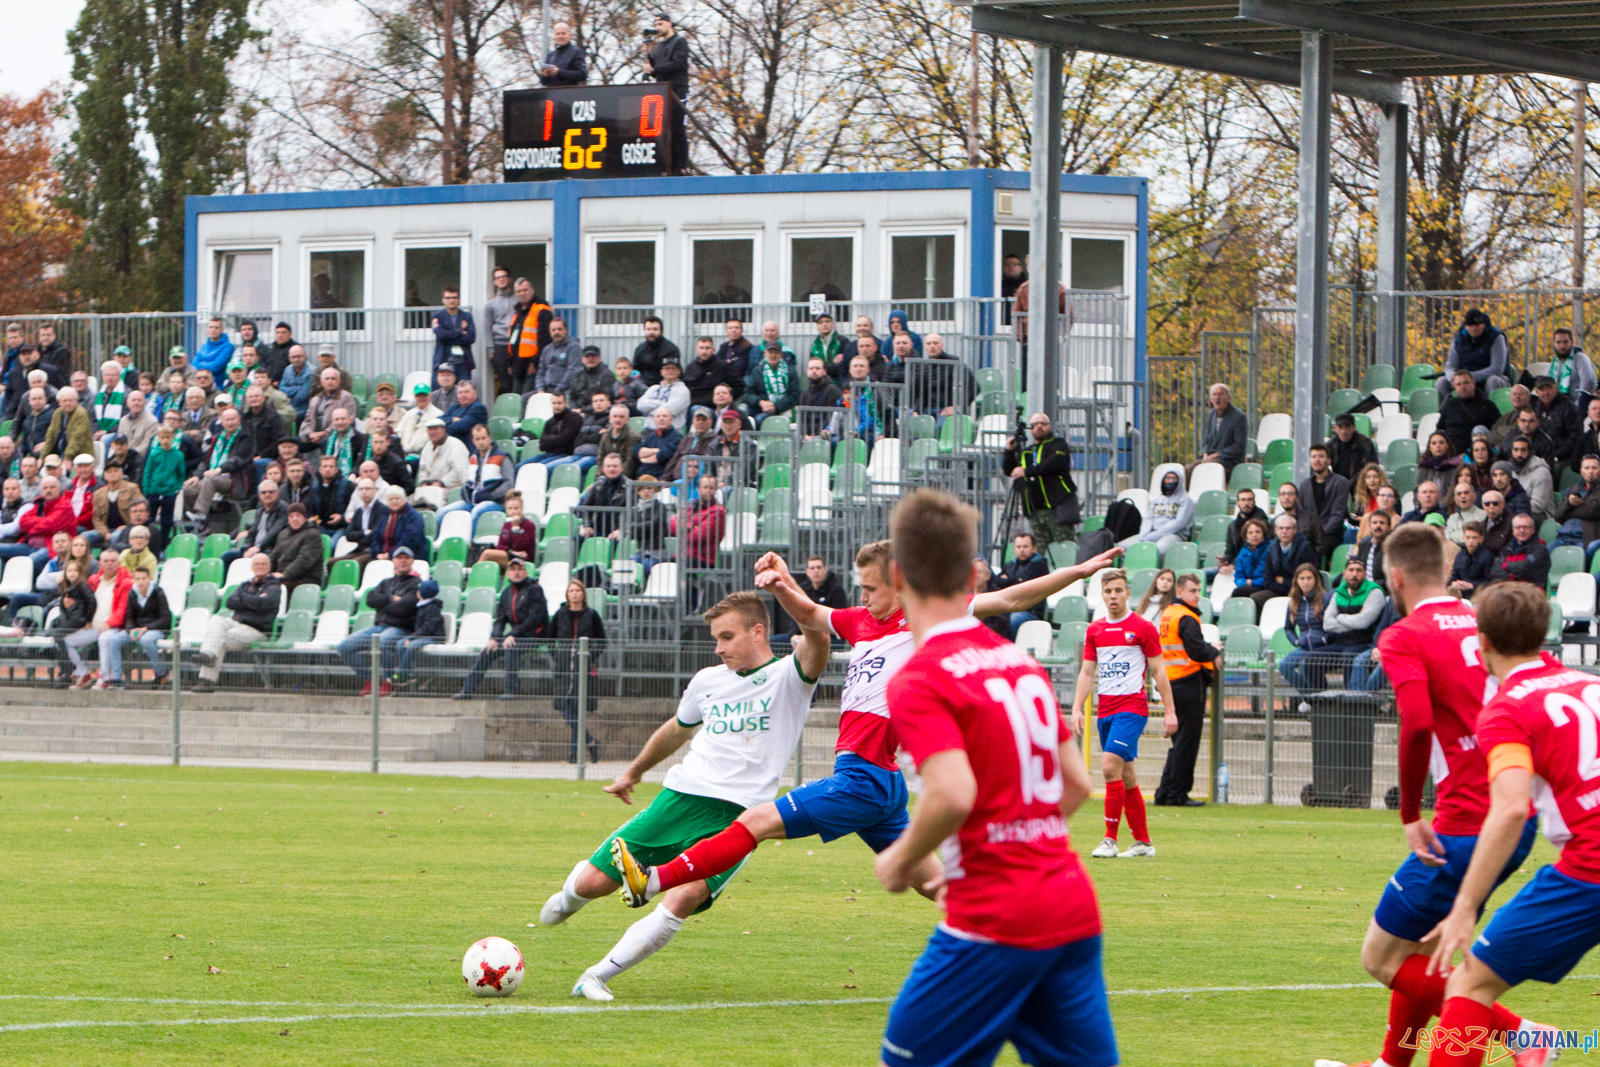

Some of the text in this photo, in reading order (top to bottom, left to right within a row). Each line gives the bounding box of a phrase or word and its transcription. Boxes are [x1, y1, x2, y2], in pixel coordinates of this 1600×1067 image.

[543, 99, 554, 142] 1
[571, 100, 597, 122] CZAS
[504, 147, 562, 170] GOSPODARZE
[563, 127, 608, 170] 62
[621, 138, 656, 165] GOŚCIE
[702, 696, 772, 719] FAMILY
[983, 674, 1064, 806] 19
